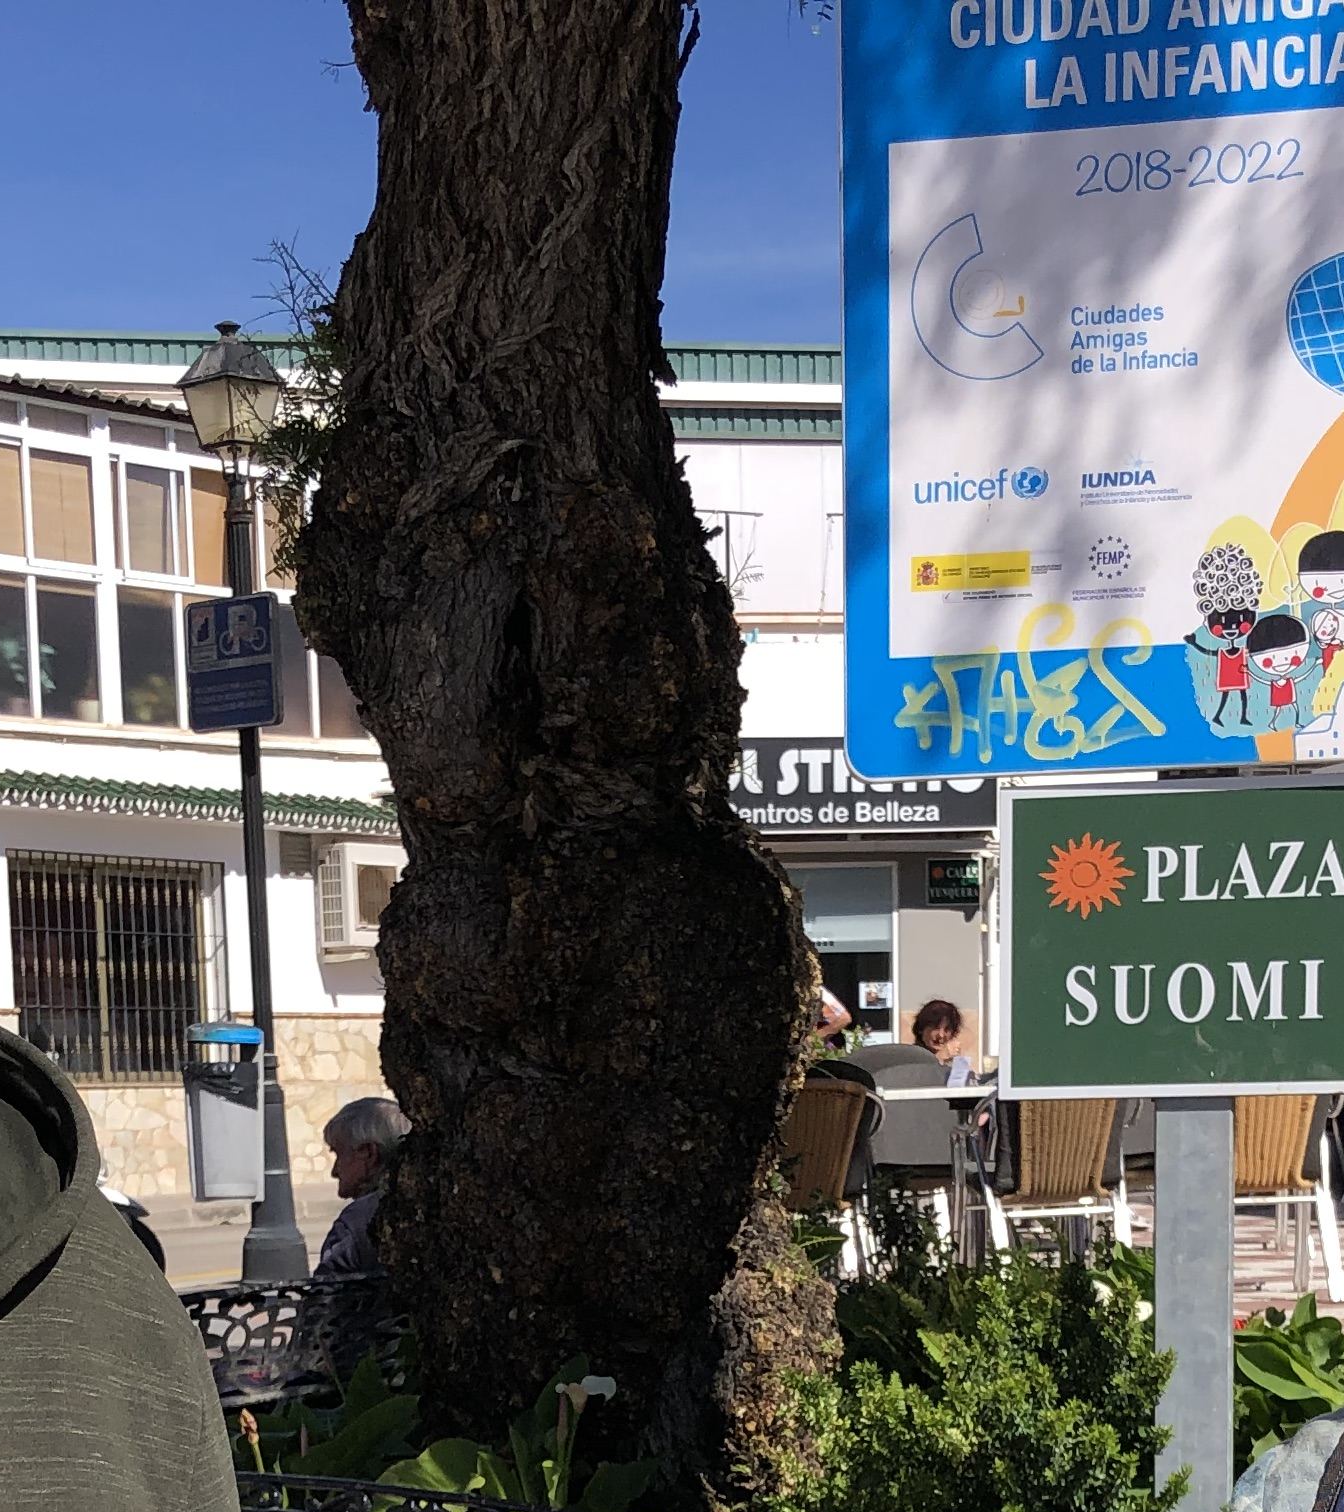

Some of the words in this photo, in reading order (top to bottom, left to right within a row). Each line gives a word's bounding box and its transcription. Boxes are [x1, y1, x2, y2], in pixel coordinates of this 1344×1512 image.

[1024, 56, 1088, 110] LA
[1074, 138, 1305, 197] 2018-2022
[1071, 302, 1165, 327] Ciudades
[1070, 329, 1149, 353] Amigas
[1071, 354, 1094, 375] de
[1100, 353, 1116, 373] la
[1123, 347, 1199, 371] Infancia
[913, 468, 1009, 504] unicef
[1081, 469, 1157, 489] IUNDIA
[1096, 551, 1125, 566] FEMP
[729, 802, 814, 825] entros
[818, 802, 850, 824] de
[855, 801, 941, 824] Belleza
[1064, 958, 1326, 1027] SUOMI
